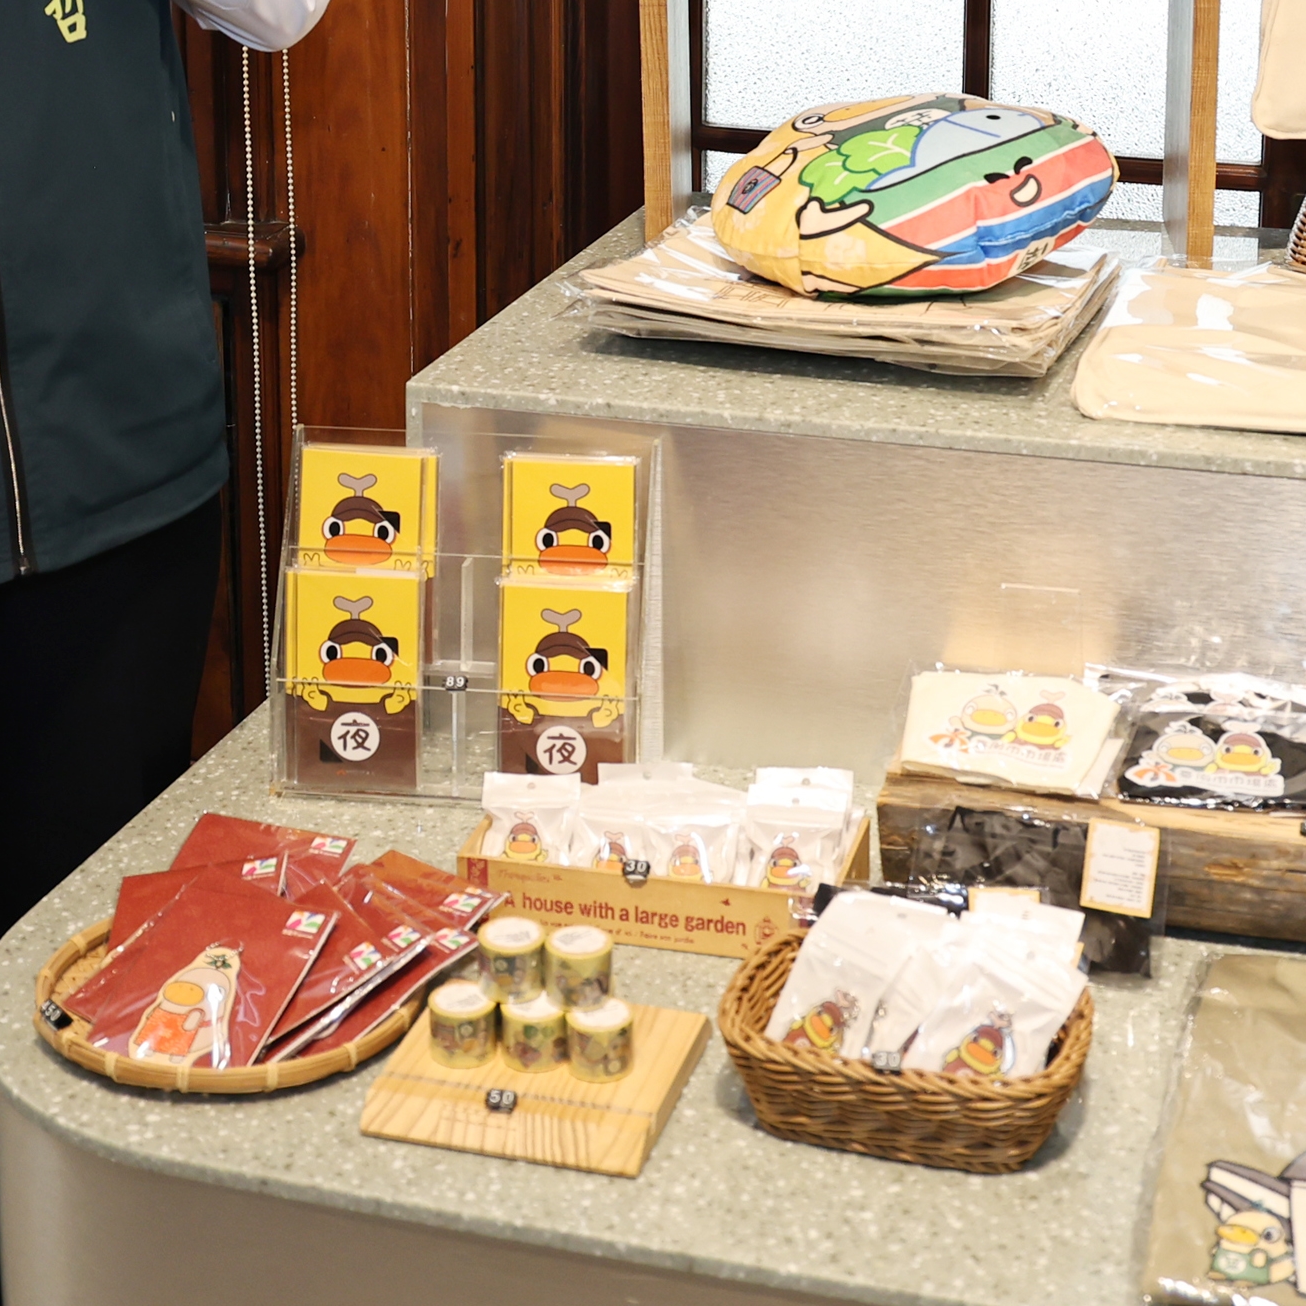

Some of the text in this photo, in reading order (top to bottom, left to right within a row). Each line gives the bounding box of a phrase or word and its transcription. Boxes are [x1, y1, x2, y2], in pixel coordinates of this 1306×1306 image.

[445, 676, 465, 688] 89
[337, 718, 372, 752] 夜
[543, 732, 578, 766] 夜
[625, 859, 647, 874] 30
[522, 892, 575, 916] house
[578, 900, 615, 921] with
[618, 908, 630, 922] a
[634, 905, 679, 929] large
[685, 910, 747, 936] garden
[489, 1090, 515, 1105] 50
